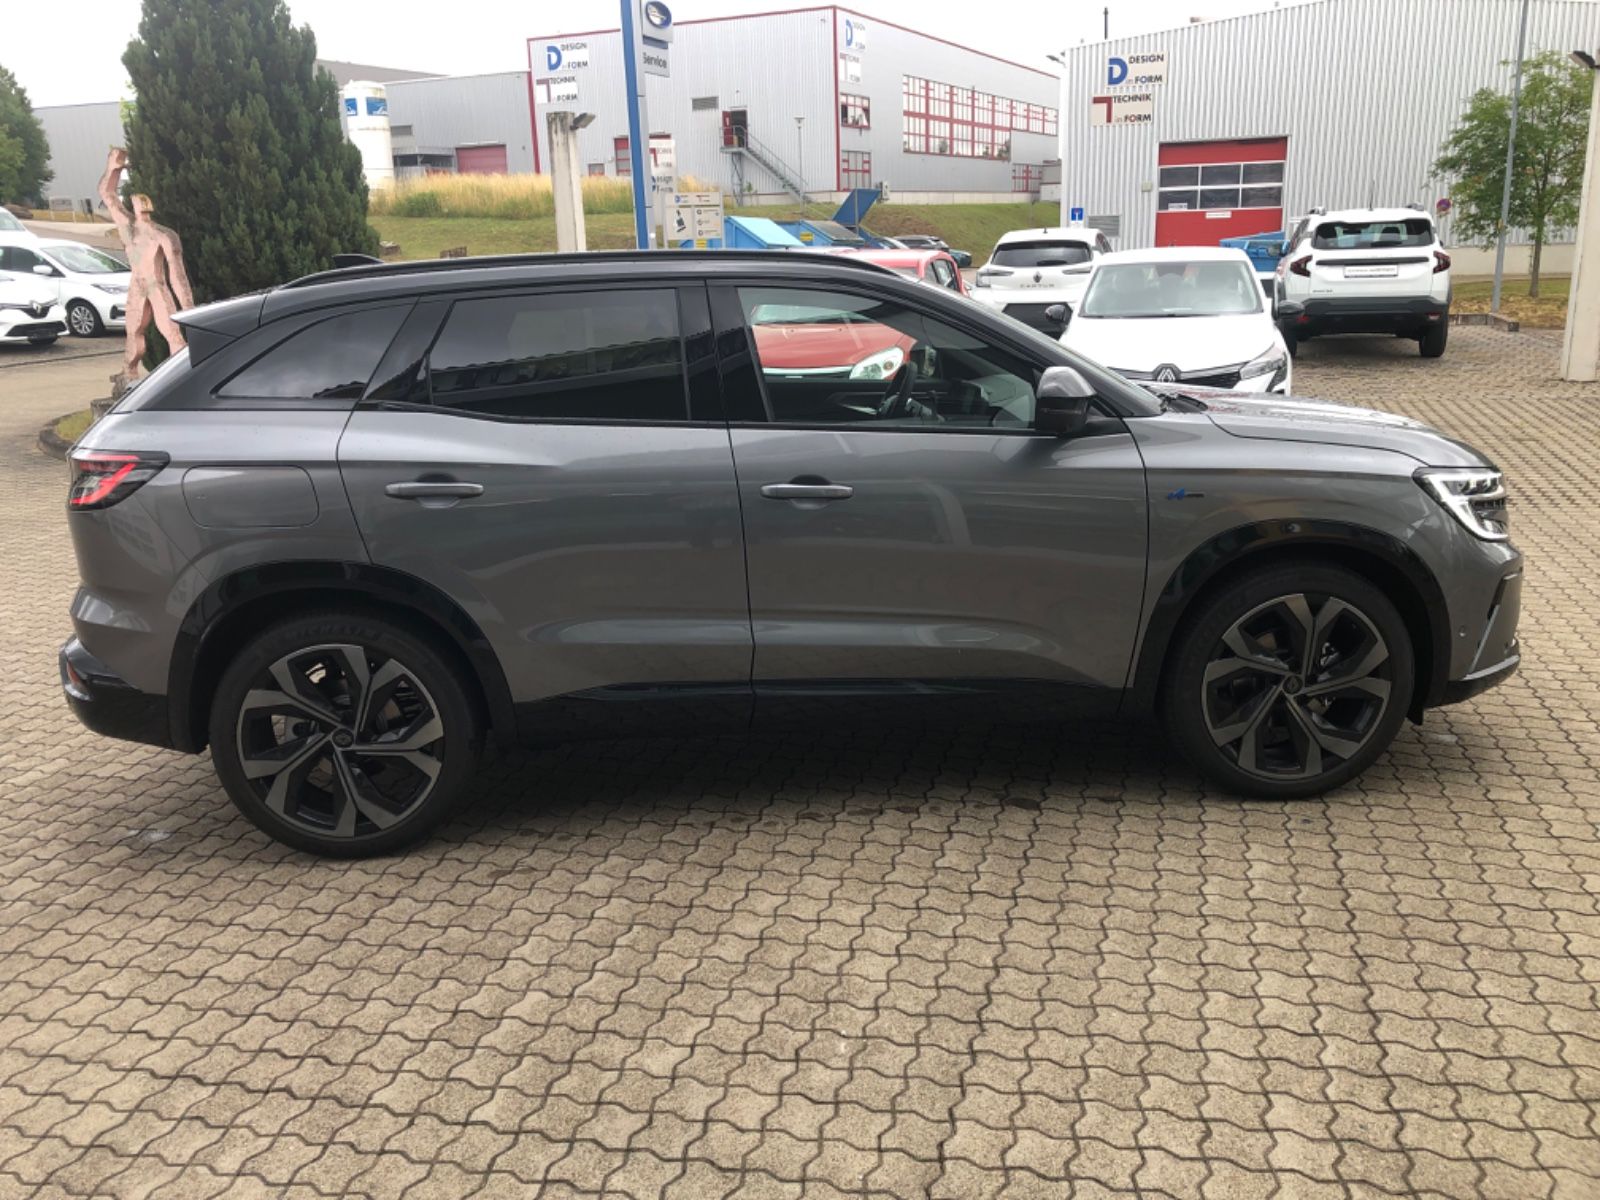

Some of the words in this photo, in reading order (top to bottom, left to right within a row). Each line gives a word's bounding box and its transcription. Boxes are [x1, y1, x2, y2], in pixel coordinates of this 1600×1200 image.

[643, 52, 668, 68] Service
[1128, 54, 1164, 64] DESIGN
[568, 60, 588, 69] FORM
[1134, 75, 1163, 84] FORM
[1113, 94, 1152, 103] TECHNIK
[1124, 114, 1152, 122] FORM
